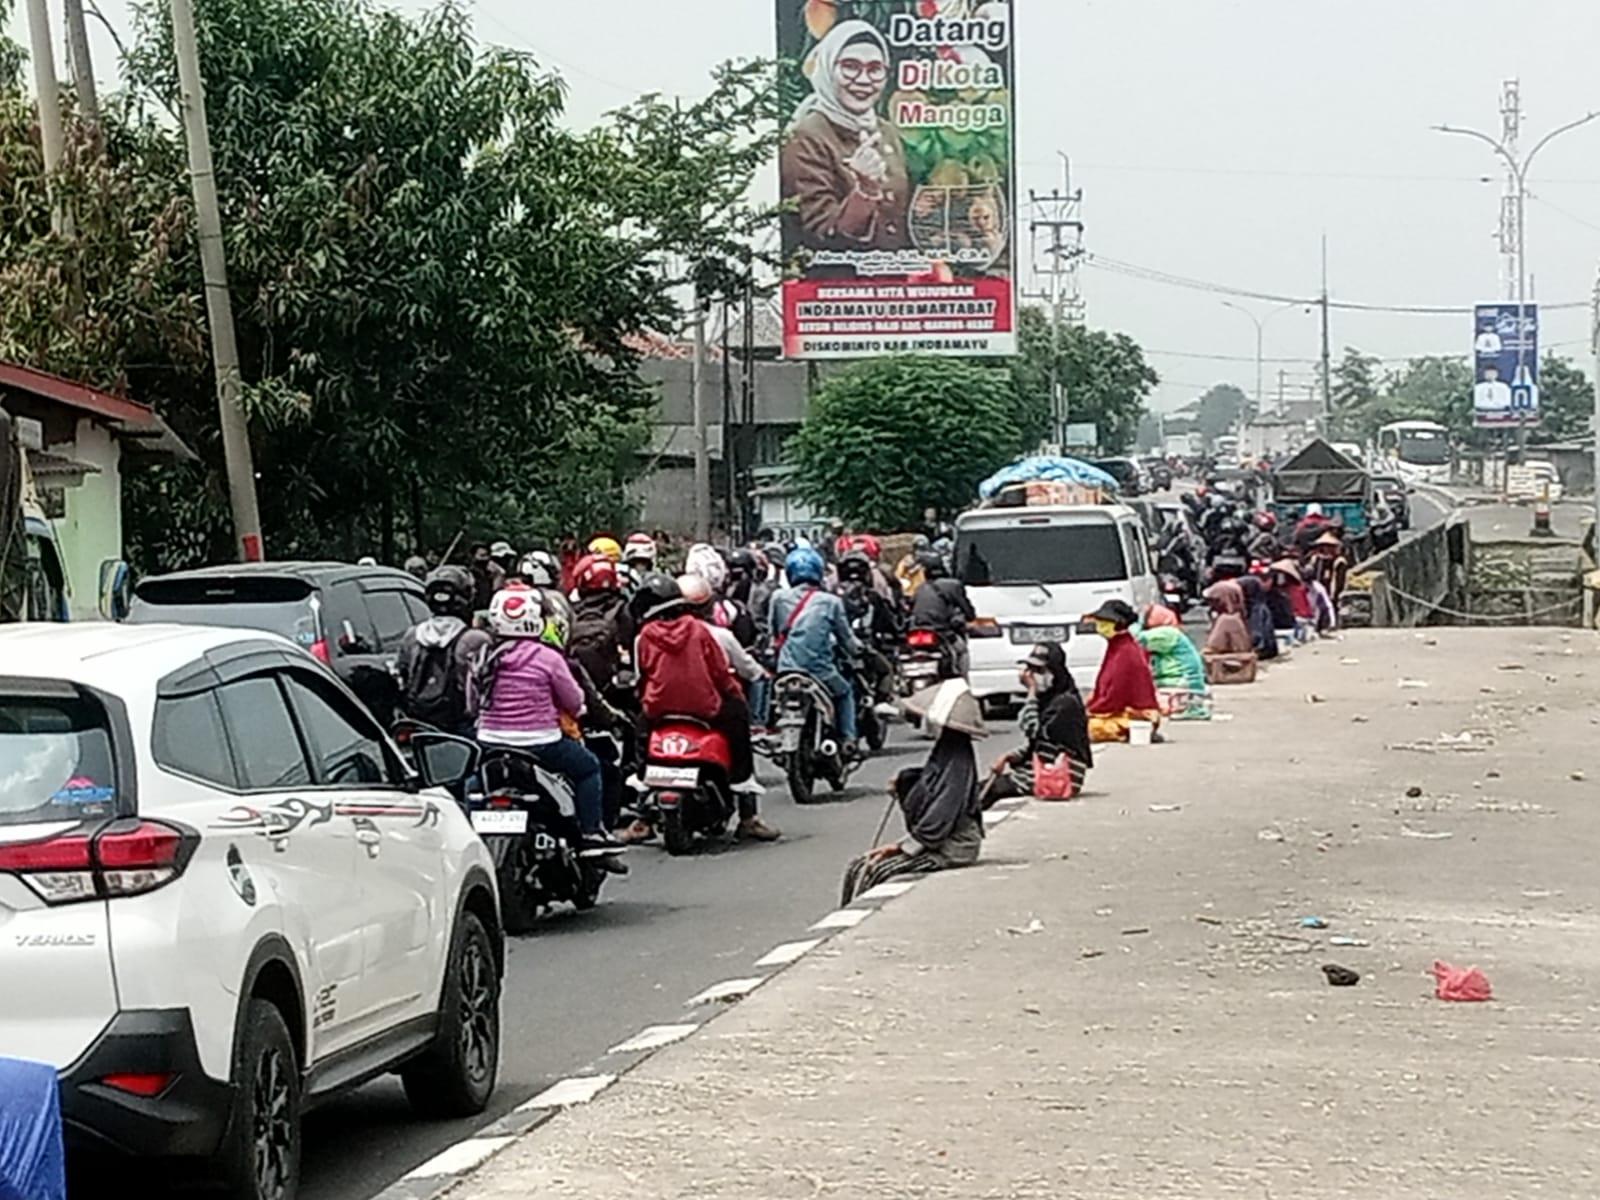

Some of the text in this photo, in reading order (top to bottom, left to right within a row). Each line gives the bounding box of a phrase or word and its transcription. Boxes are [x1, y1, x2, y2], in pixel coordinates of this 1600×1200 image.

[893, 17, 1006, 46] Datang
[901, 64, 999, 86] Di Kota
[899, 105, 1003, 127] Mangga
[799, 302, 994, 316] INDRAMAYU BERMARTABAT
